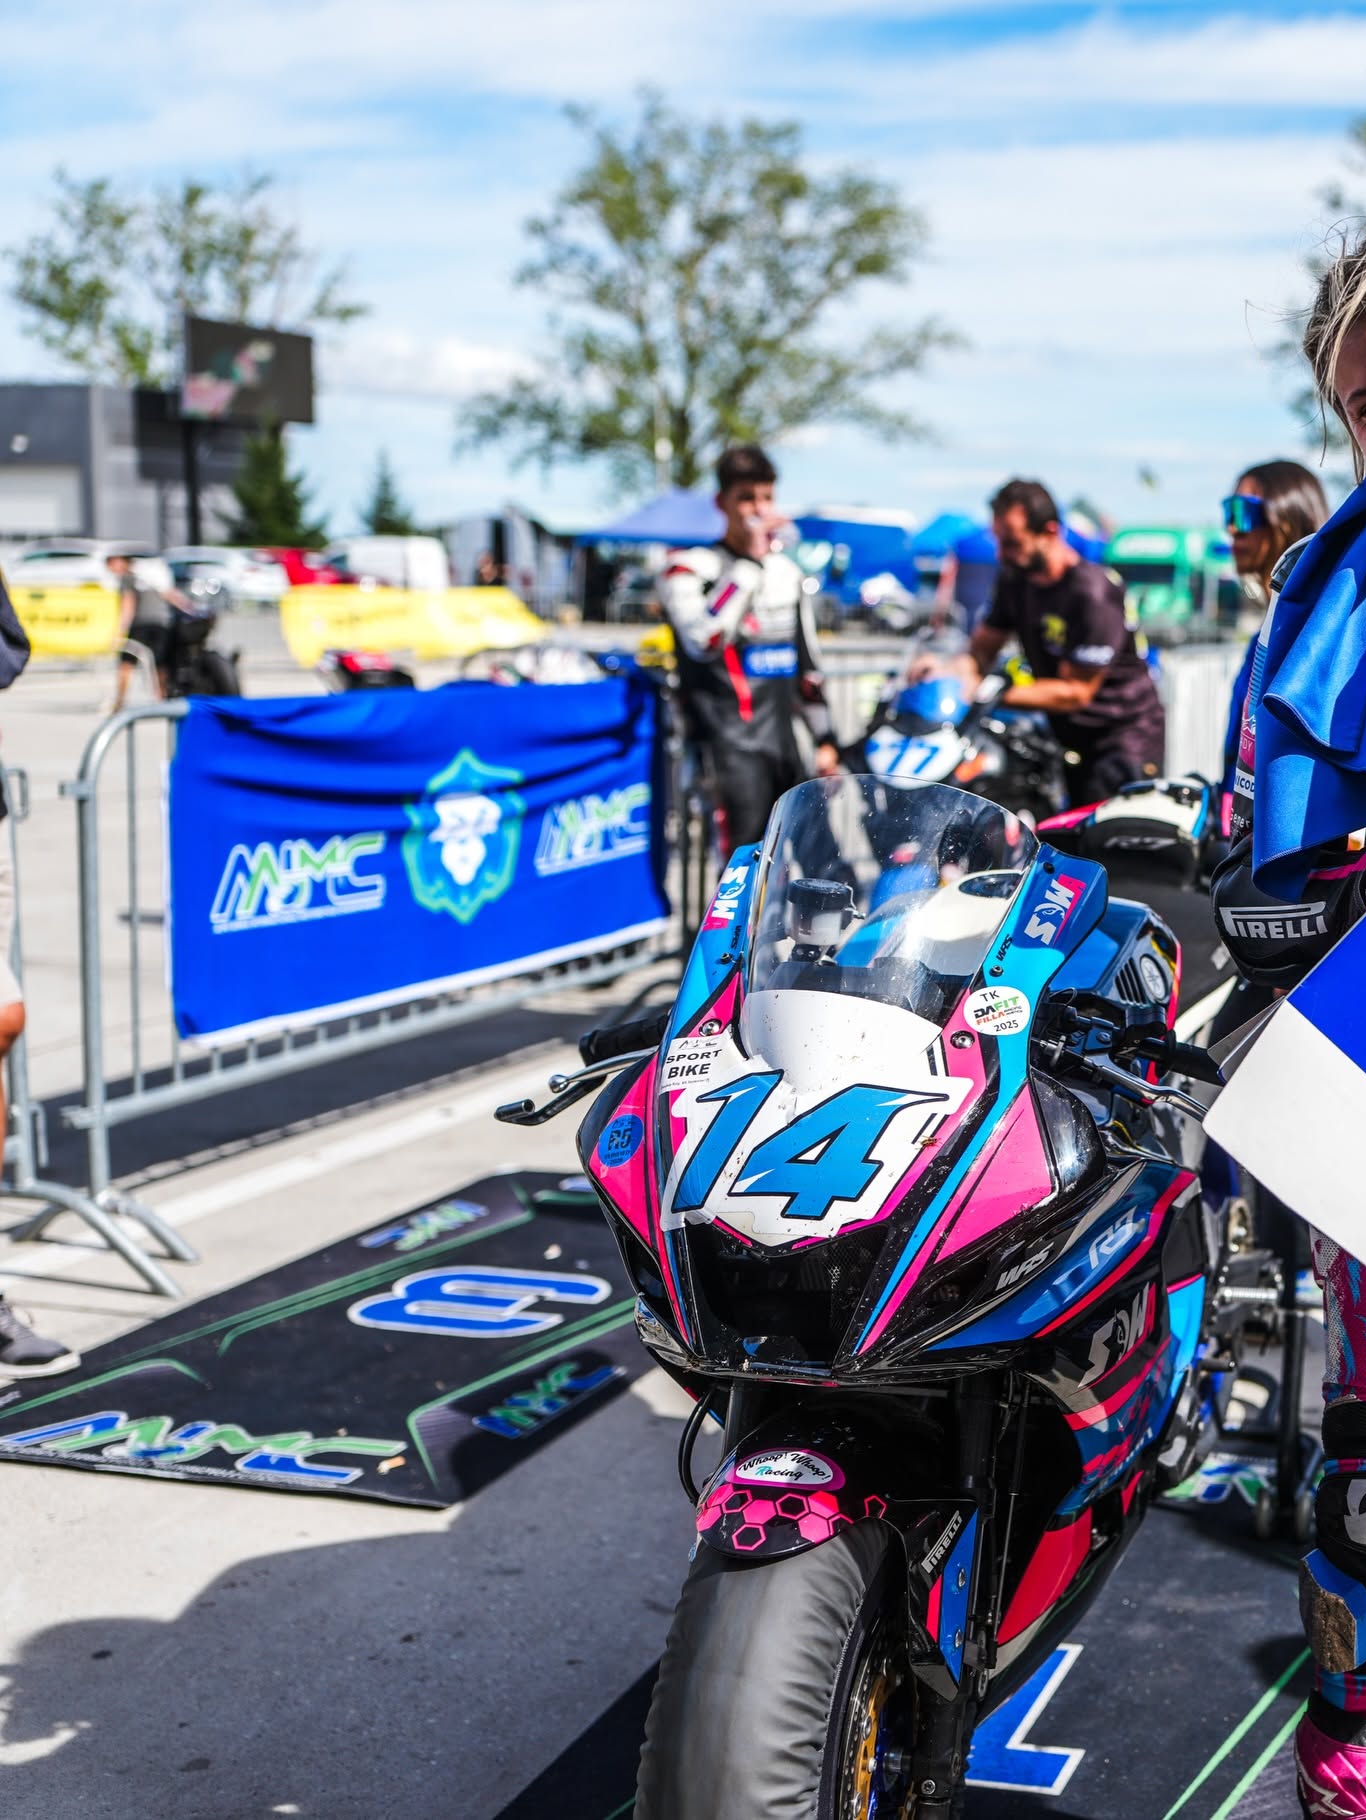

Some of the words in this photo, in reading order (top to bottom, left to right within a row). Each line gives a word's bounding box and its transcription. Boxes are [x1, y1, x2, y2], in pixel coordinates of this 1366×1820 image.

[1219, 901, 1329, 939] PIRELLI
[973, 996, 1020, 1019] DAFIT
[975, 1010, 1005, 1026] FILLA
[993, 1020, 1019, 1032] 2025
[666, 1049, 723, 1064] SPORT
[667, 1063, 712, 1079] BIKE
[671, 1068, 950, 1220] 14
[738, 1451, 788, 1472] Whoop!
[790, 1452, 832, 1481] Whoop!
[755, 1465, 805, 1481] Racing
[921, 1509, 963, 1574] PIRELLI
